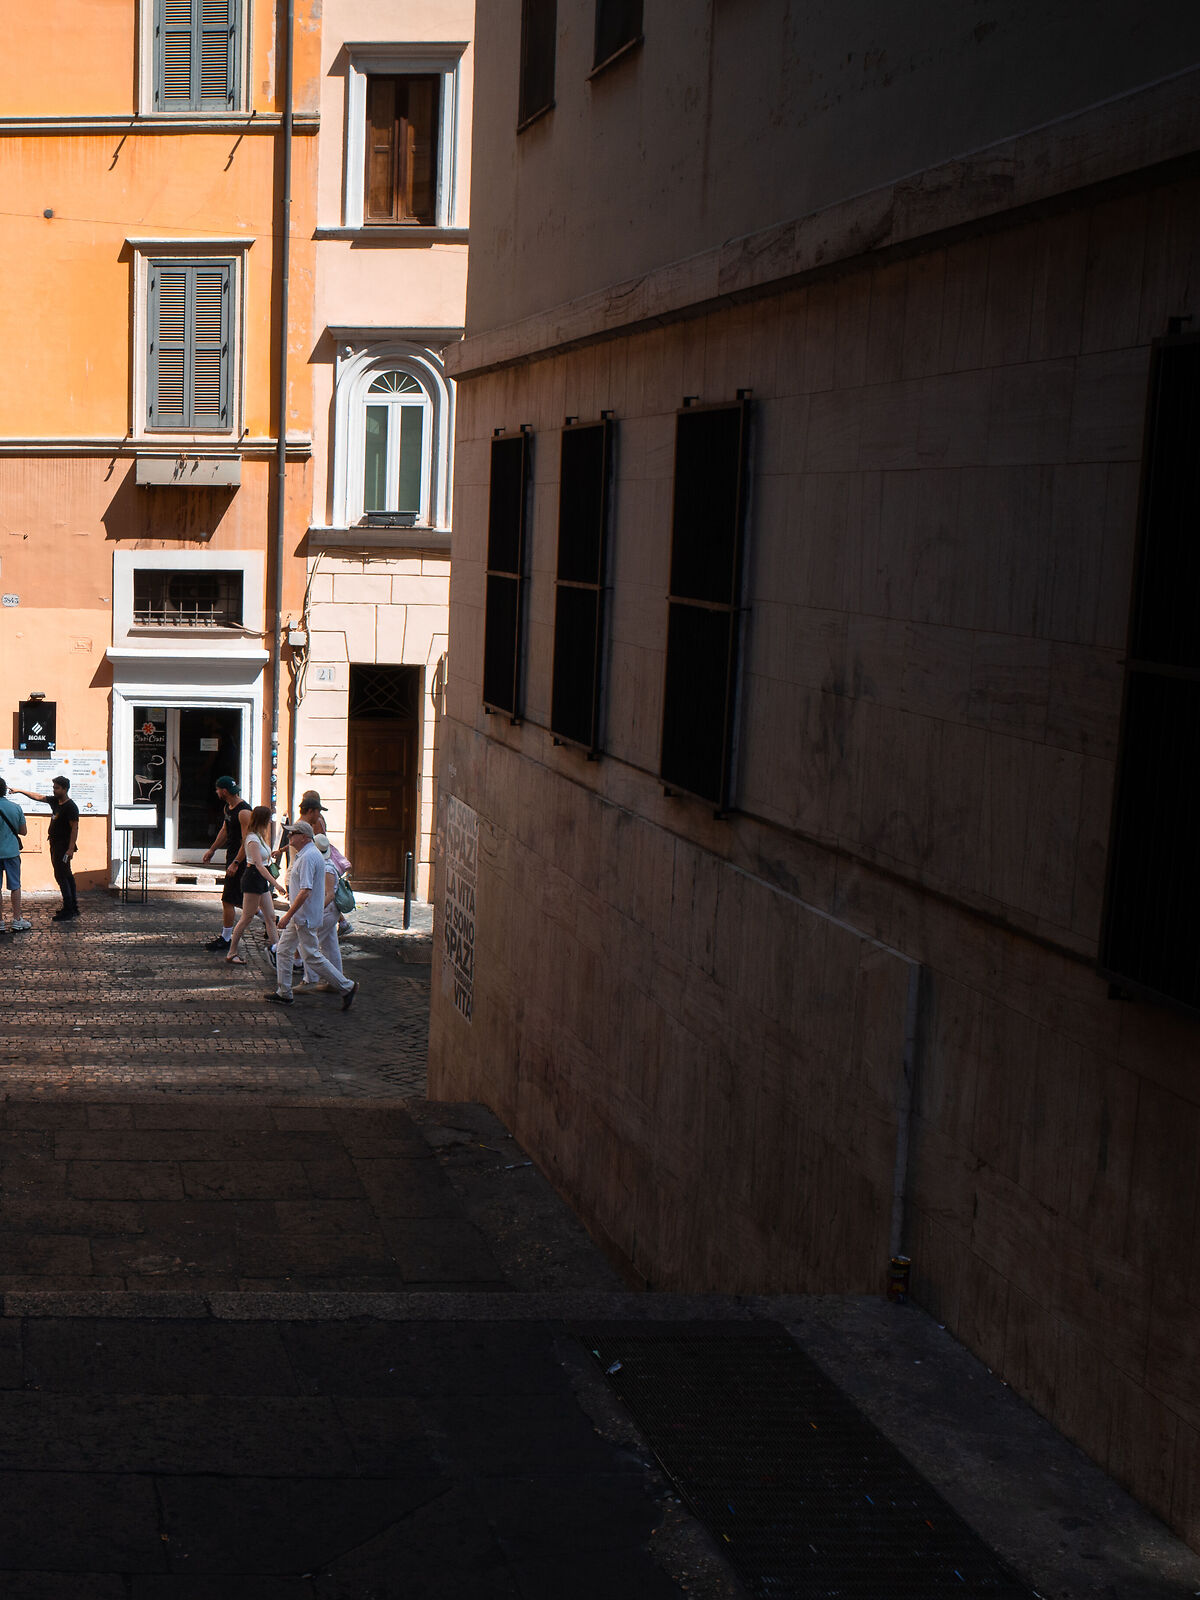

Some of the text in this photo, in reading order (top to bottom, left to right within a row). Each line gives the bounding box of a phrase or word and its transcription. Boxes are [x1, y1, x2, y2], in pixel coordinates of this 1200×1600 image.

[319, 669, 331, 680] 21
[457, 876, 476, 916] VITA
[454, 905, 475, 946] SONO
[454, 979, 473, 1022] VITA
